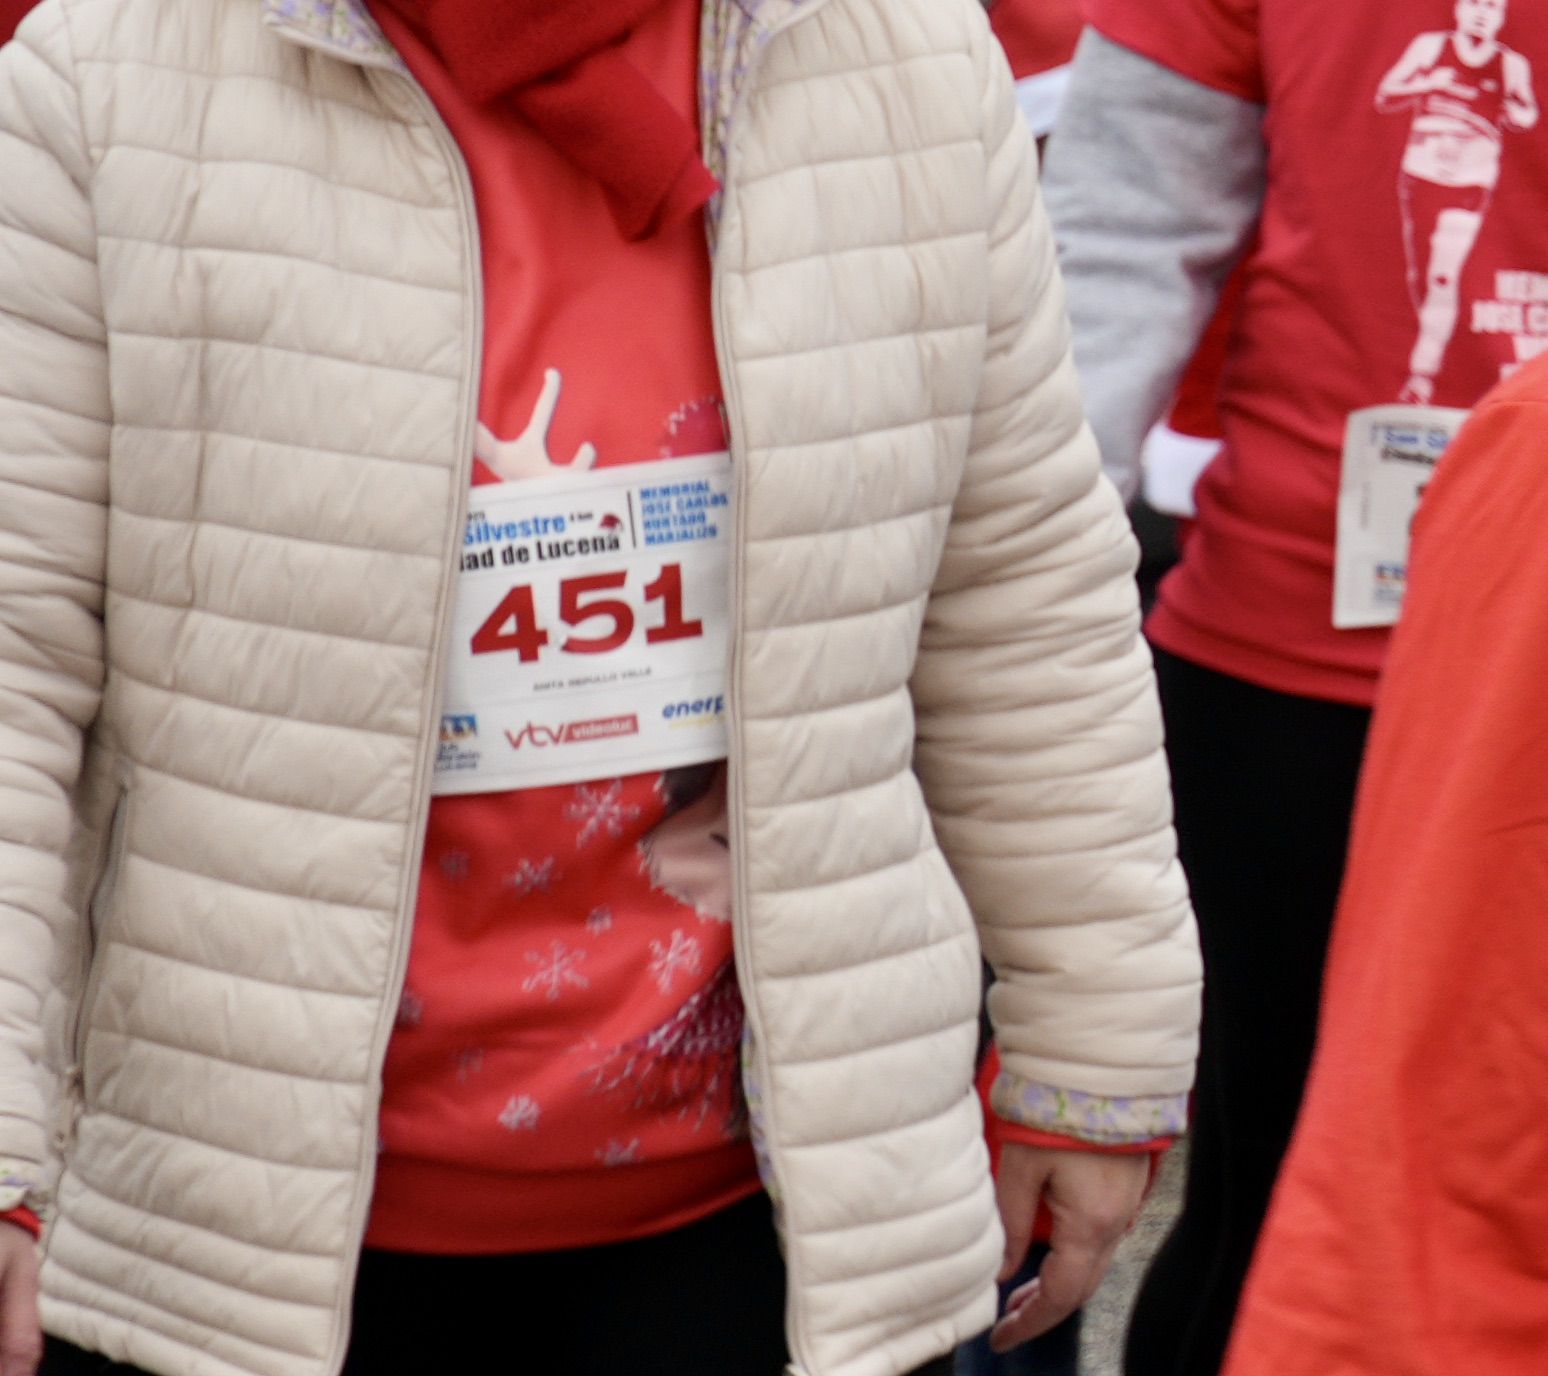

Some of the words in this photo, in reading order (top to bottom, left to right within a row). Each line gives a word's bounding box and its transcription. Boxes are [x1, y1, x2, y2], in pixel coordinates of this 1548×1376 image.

[501, 543, 531, 565] de
[537, 535, 621, 562] Lucena
[470, 562, 703, 665] 451
[661, 693, 724, 720] enerp
